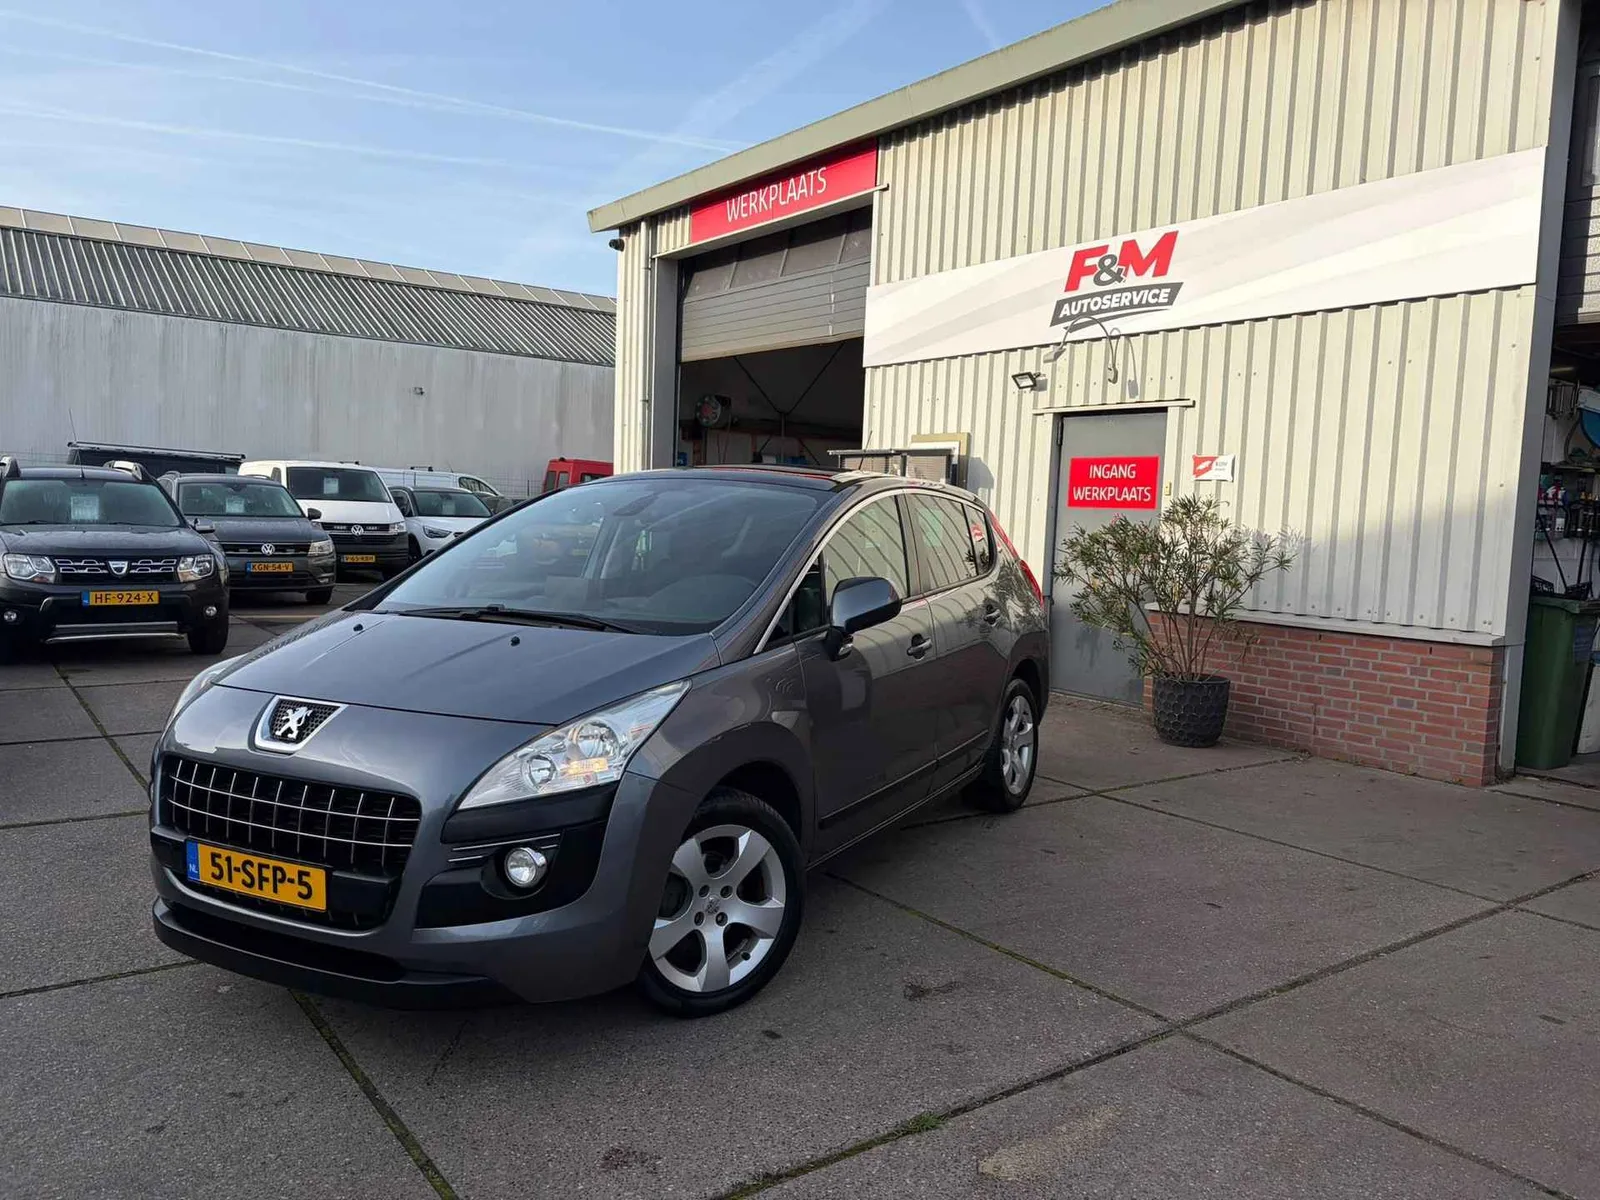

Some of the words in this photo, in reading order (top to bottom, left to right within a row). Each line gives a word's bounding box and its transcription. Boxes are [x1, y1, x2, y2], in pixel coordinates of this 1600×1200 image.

[726, 166, 827, 223] WERKPLAATS
[1064, 230, 1179, 292] F&M
[1059, 288, 1171, 319] AUTOSERVICE
[1089, 463, 1137, 479] INGANG
[1072, 486, 1153, 502] WERKPLAATS
[253, 563, 290, 571] KGN-54-V
[94, 592, 155, 604] HF-924-X
[189, 863, 198, 873] NL
[210, 851, 313, 900] 51-SFP-5
